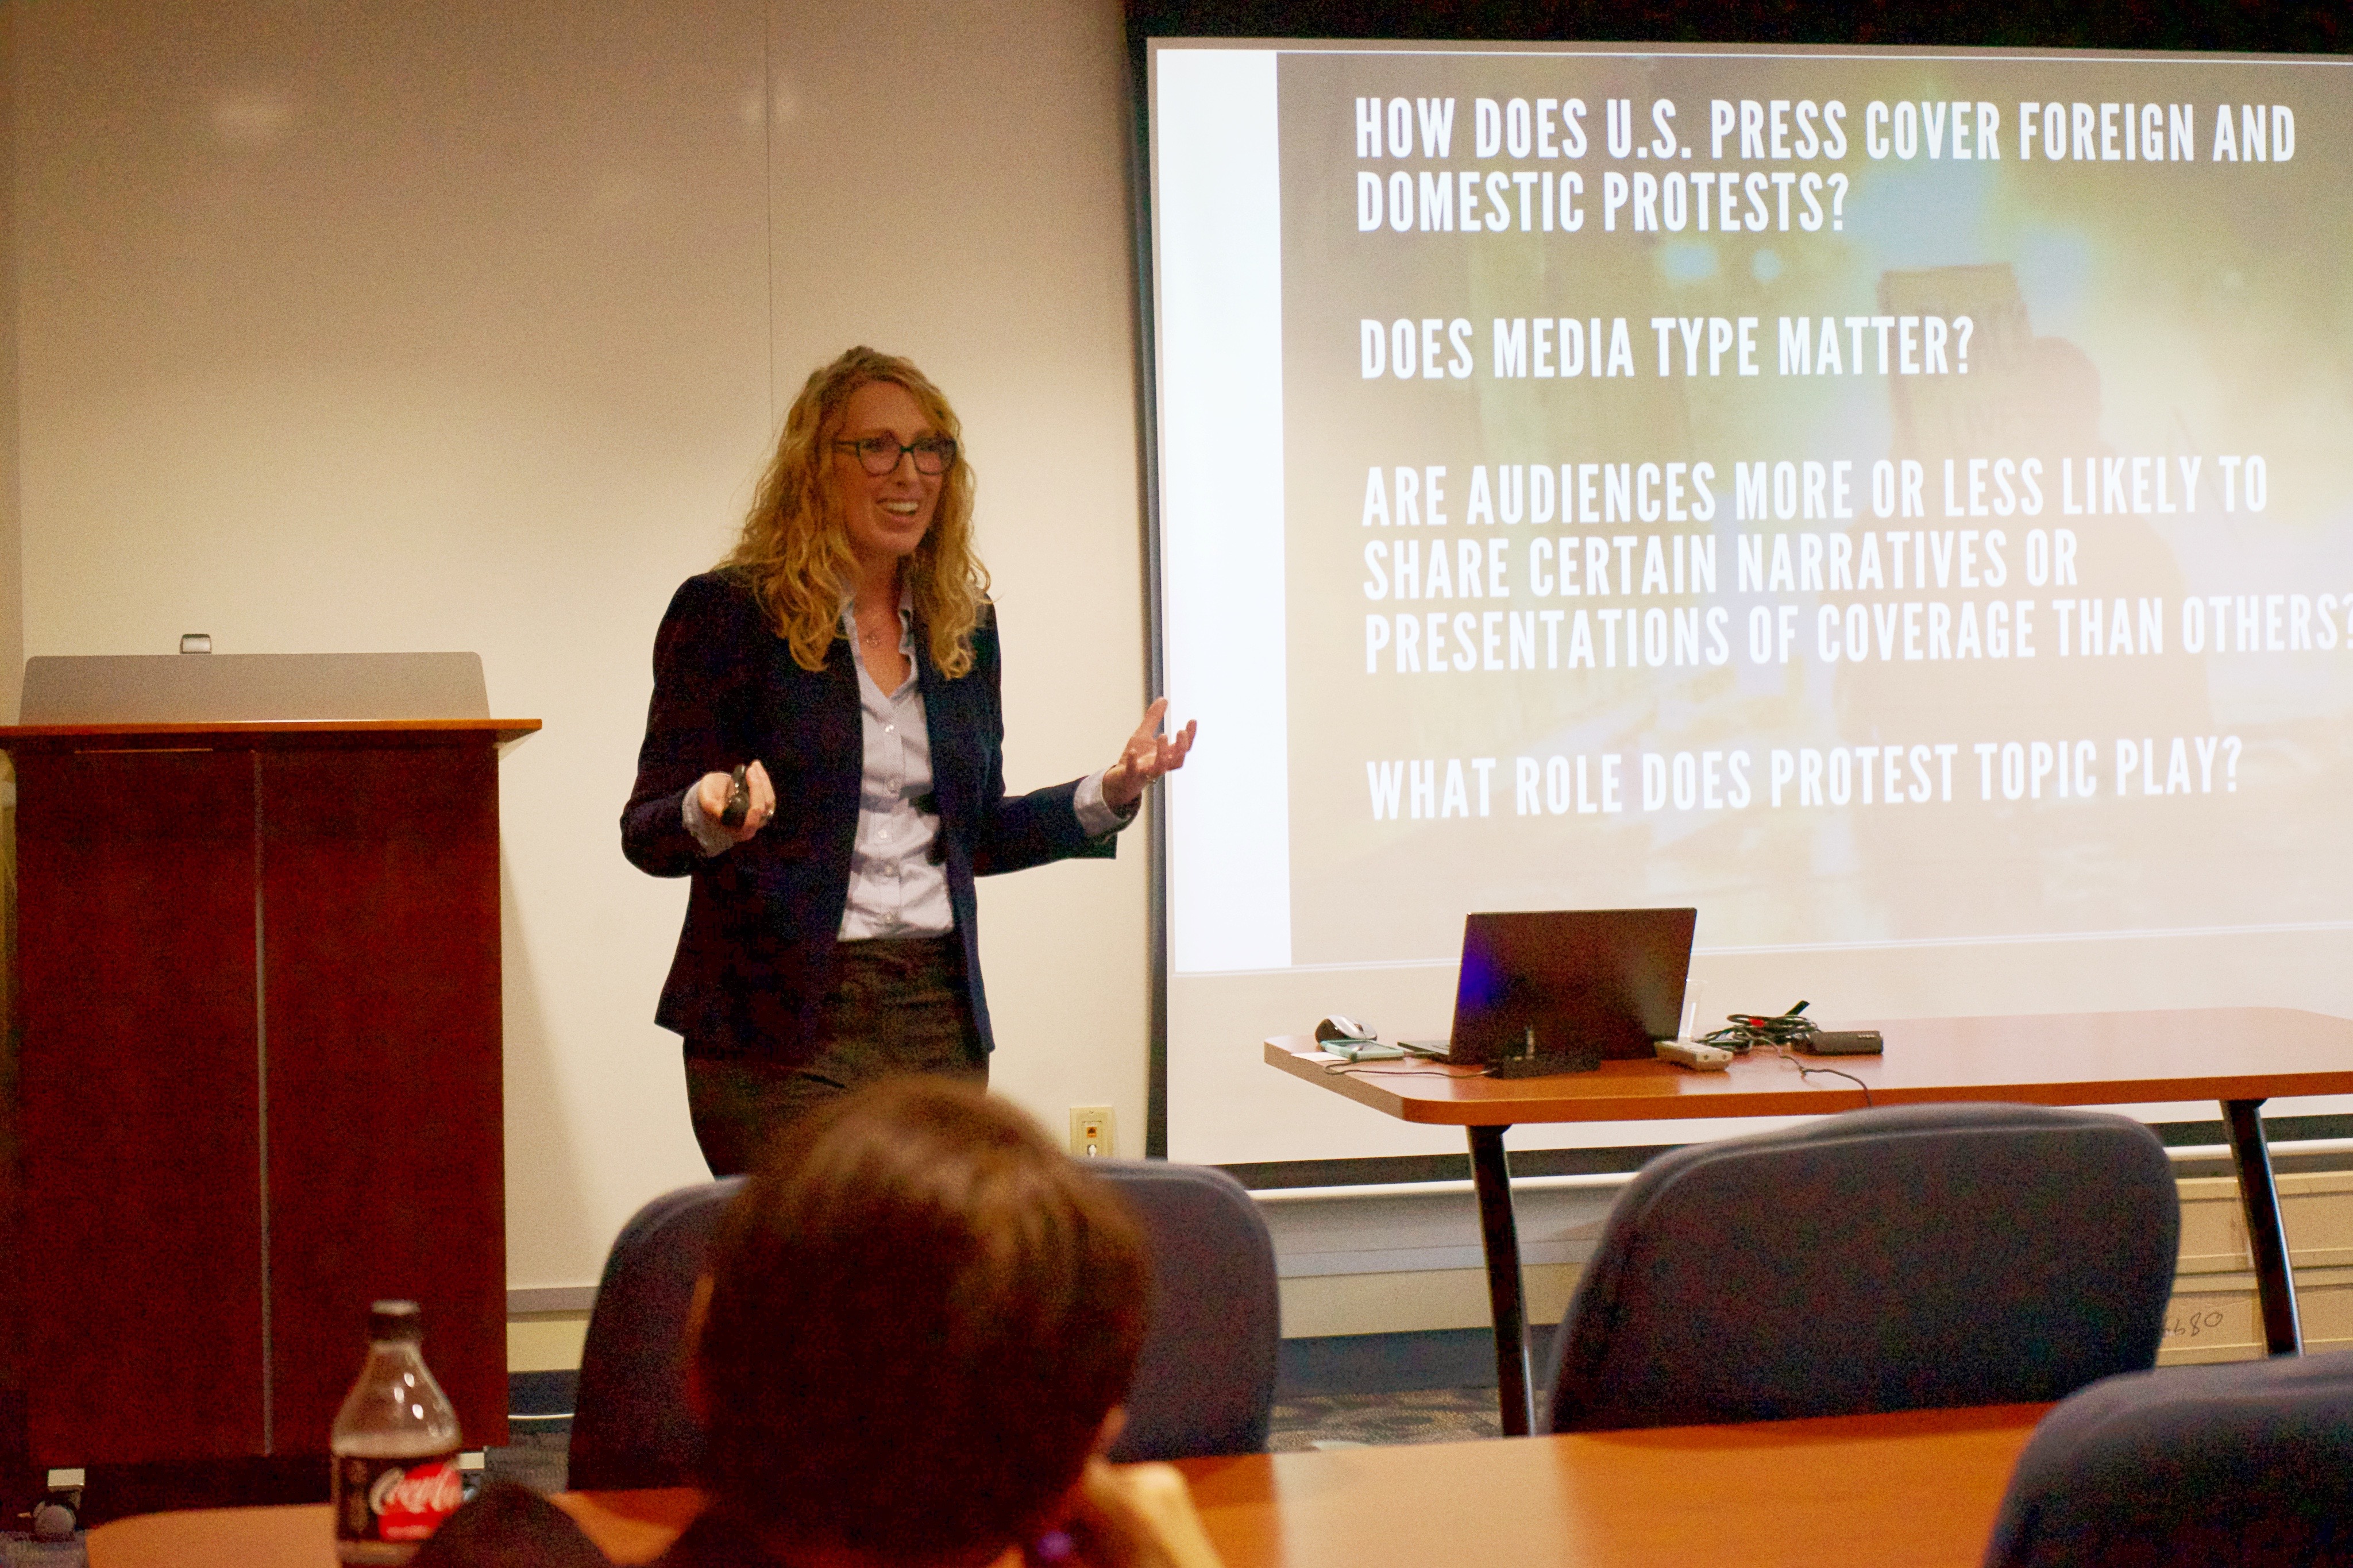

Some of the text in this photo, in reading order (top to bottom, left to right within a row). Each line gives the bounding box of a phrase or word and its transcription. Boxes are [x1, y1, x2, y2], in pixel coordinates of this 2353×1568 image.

[1356, 98, 2294, 162] HOW DOES U.S. PRESS COVER FOREIGN AND
[1357, 171, 1849, 232] DOMESTIC PROTESTS?
[1361, 316, 1973, 379] DOES MEDIA TYPE MATTER?
[1362, 455, 2266, 527] ARE AUDIENCES MORE OR LESS LIKELY TO
[1363, 528, 2077, 601] SHARE CERTAIN NARRATIVES OR
[1367, 607, 1730, 673] PRESENTATIONS
[1749, 605, 1798, 665] OF
[1816, 601, 2035, 663] COVERAGE
[2052, 597, 2162, 656] THAN
[1367, 736, 2242, 820] WHAT ROLE DOES PROTEST TOPIC PLAY?
